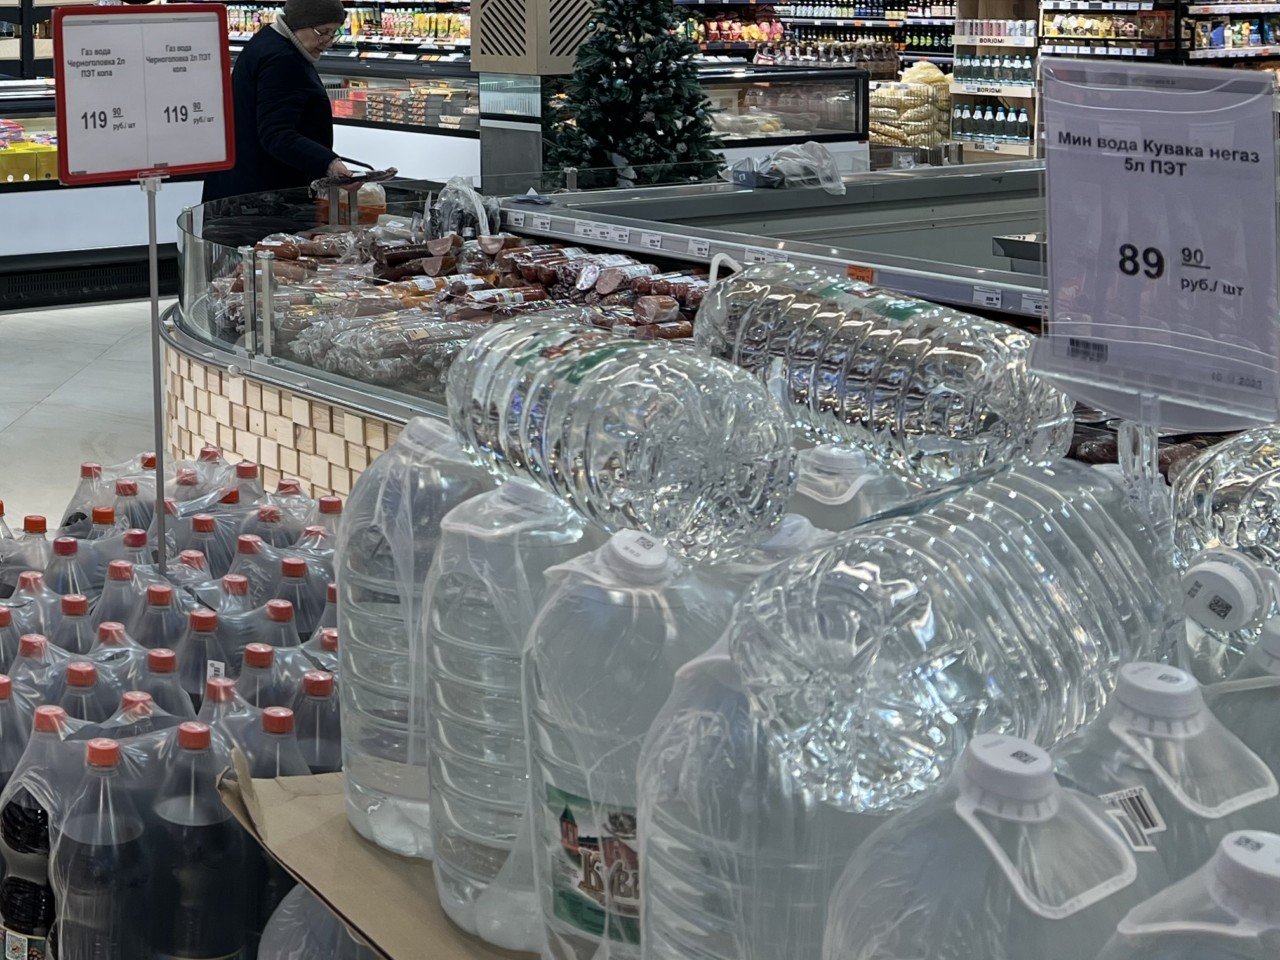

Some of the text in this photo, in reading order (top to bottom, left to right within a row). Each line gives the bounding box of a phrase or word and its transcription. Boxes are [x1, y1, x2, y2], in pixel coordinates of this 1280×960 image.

[81, 48, 111, 56] Газ вода
[81, 69, 113, 78] ПЭТ кола
[112, 107, 121, 116] 90
[164, 104, 189, 123] 119
[192, 101, 202, 110] 90
[80, 110, 108, 130] 119
[1058, 131, 1260, 164] Мин вода Кувака негаз
[1123, 159, 1187, 177] 5л ПЭТ
[1119, 243, 1166, 280] 89
[1181, 247, 1204, 264] 90
[1222, 281, 1245, 297] шт
